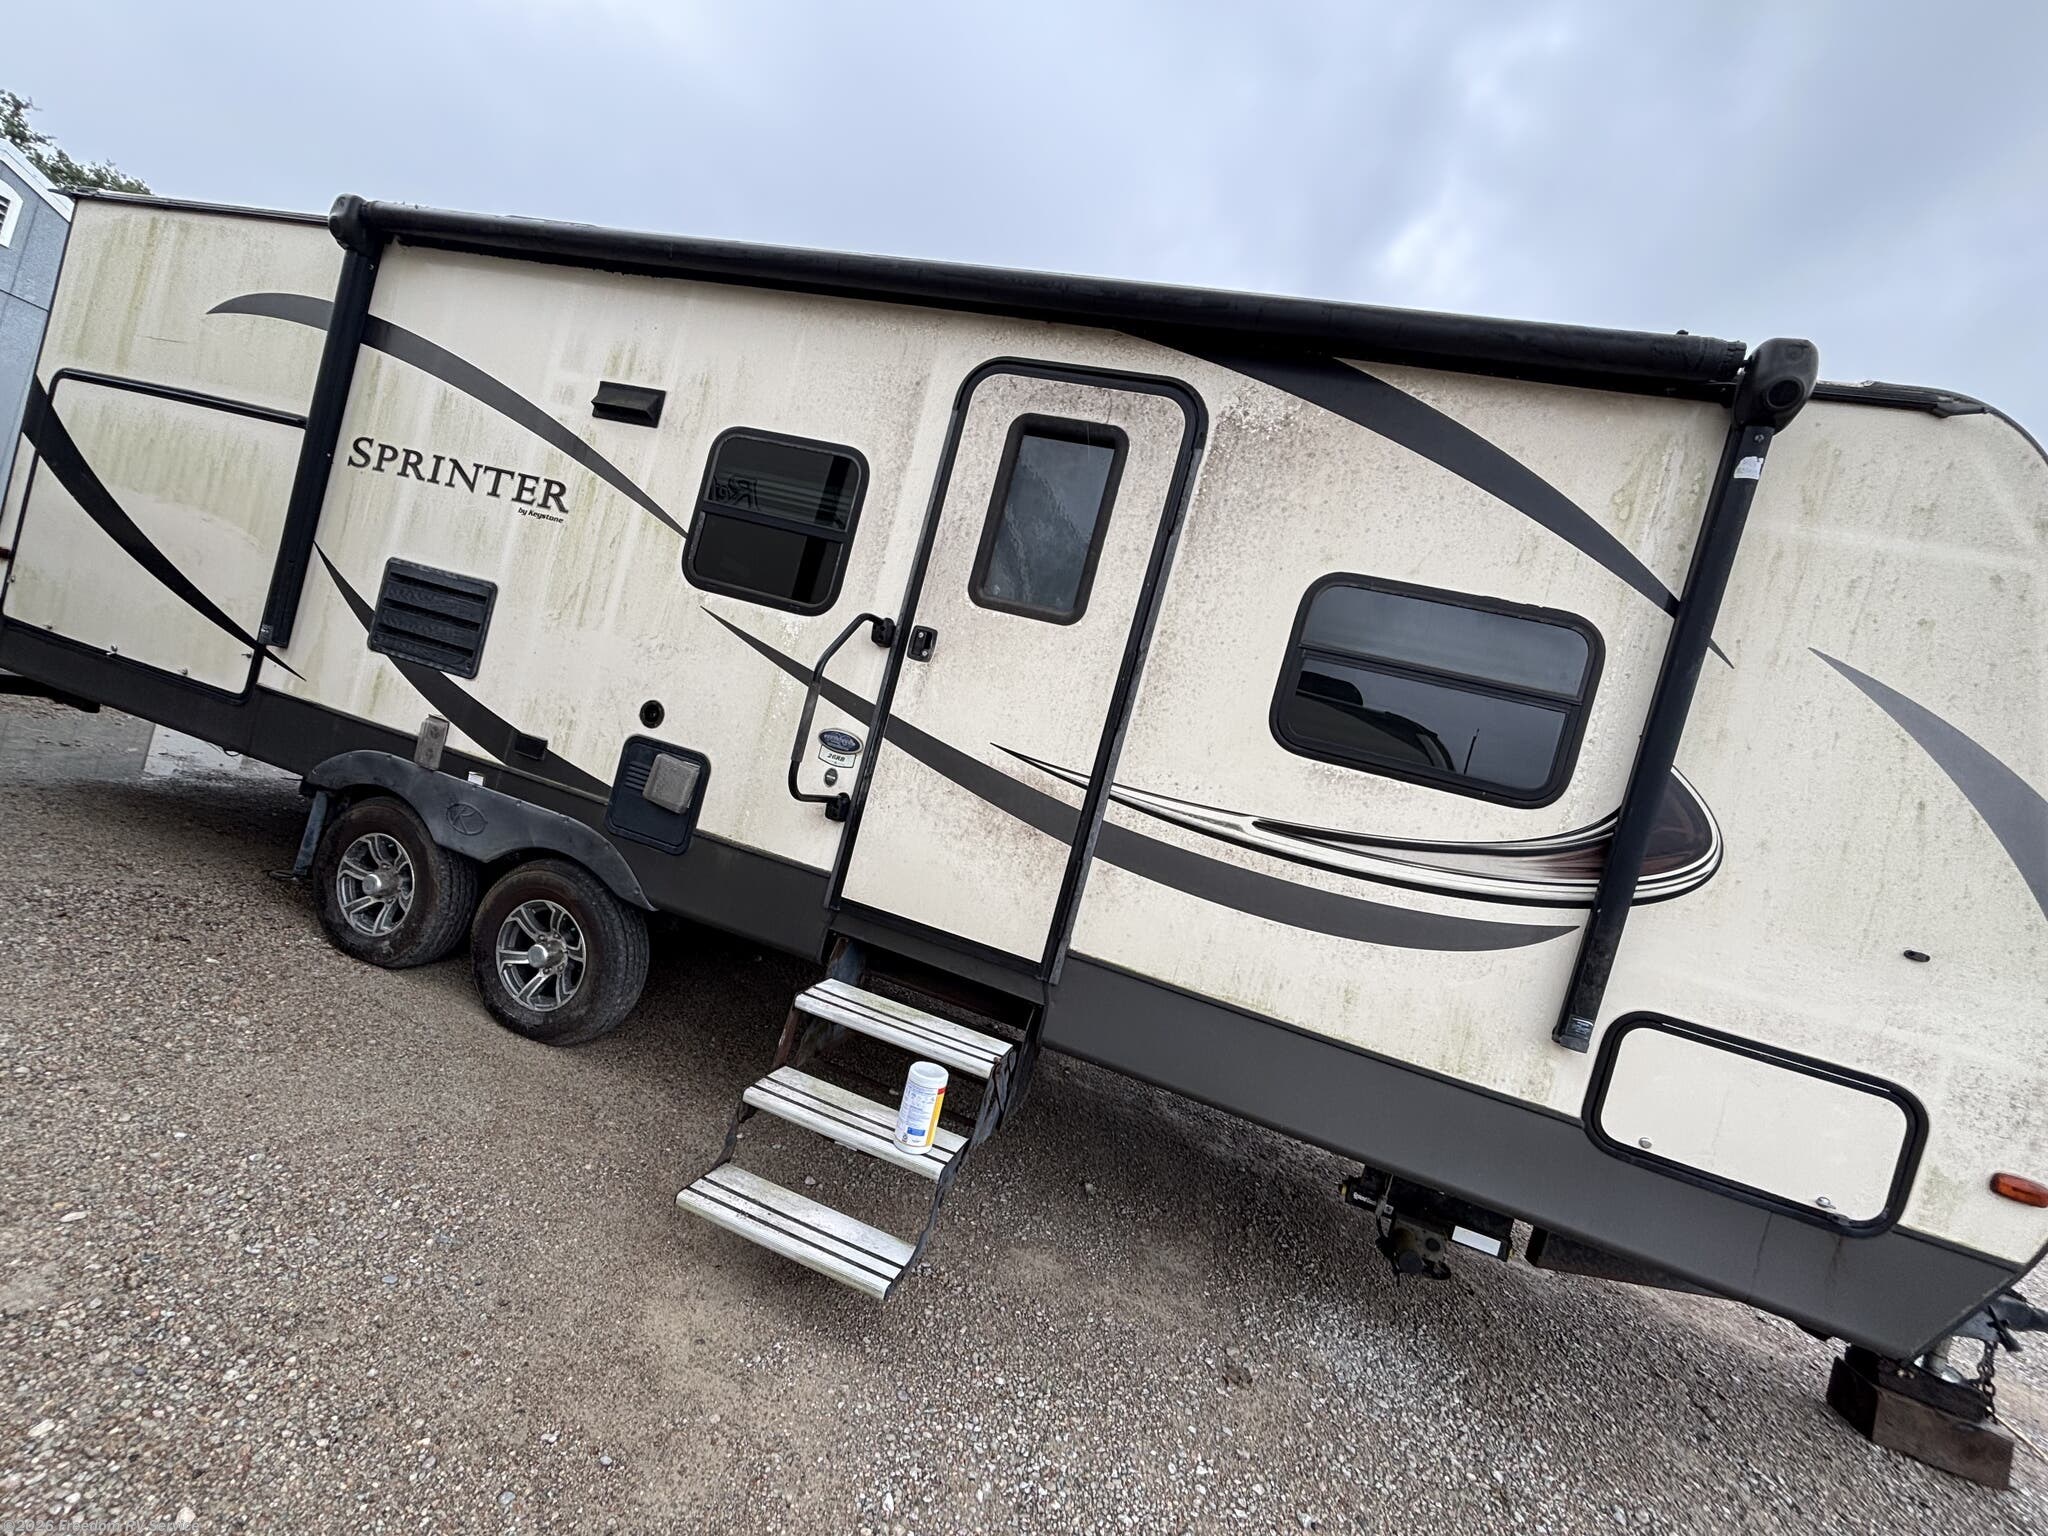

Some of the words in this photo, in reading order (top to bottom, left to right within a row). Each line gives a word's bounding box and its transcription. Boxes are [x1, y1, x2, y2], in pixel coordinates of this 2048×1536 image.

[347, 437, 569, 514] SPRINTER
[518, 507, 528, 516] by
[528, 510, 564, 523] Keystone
